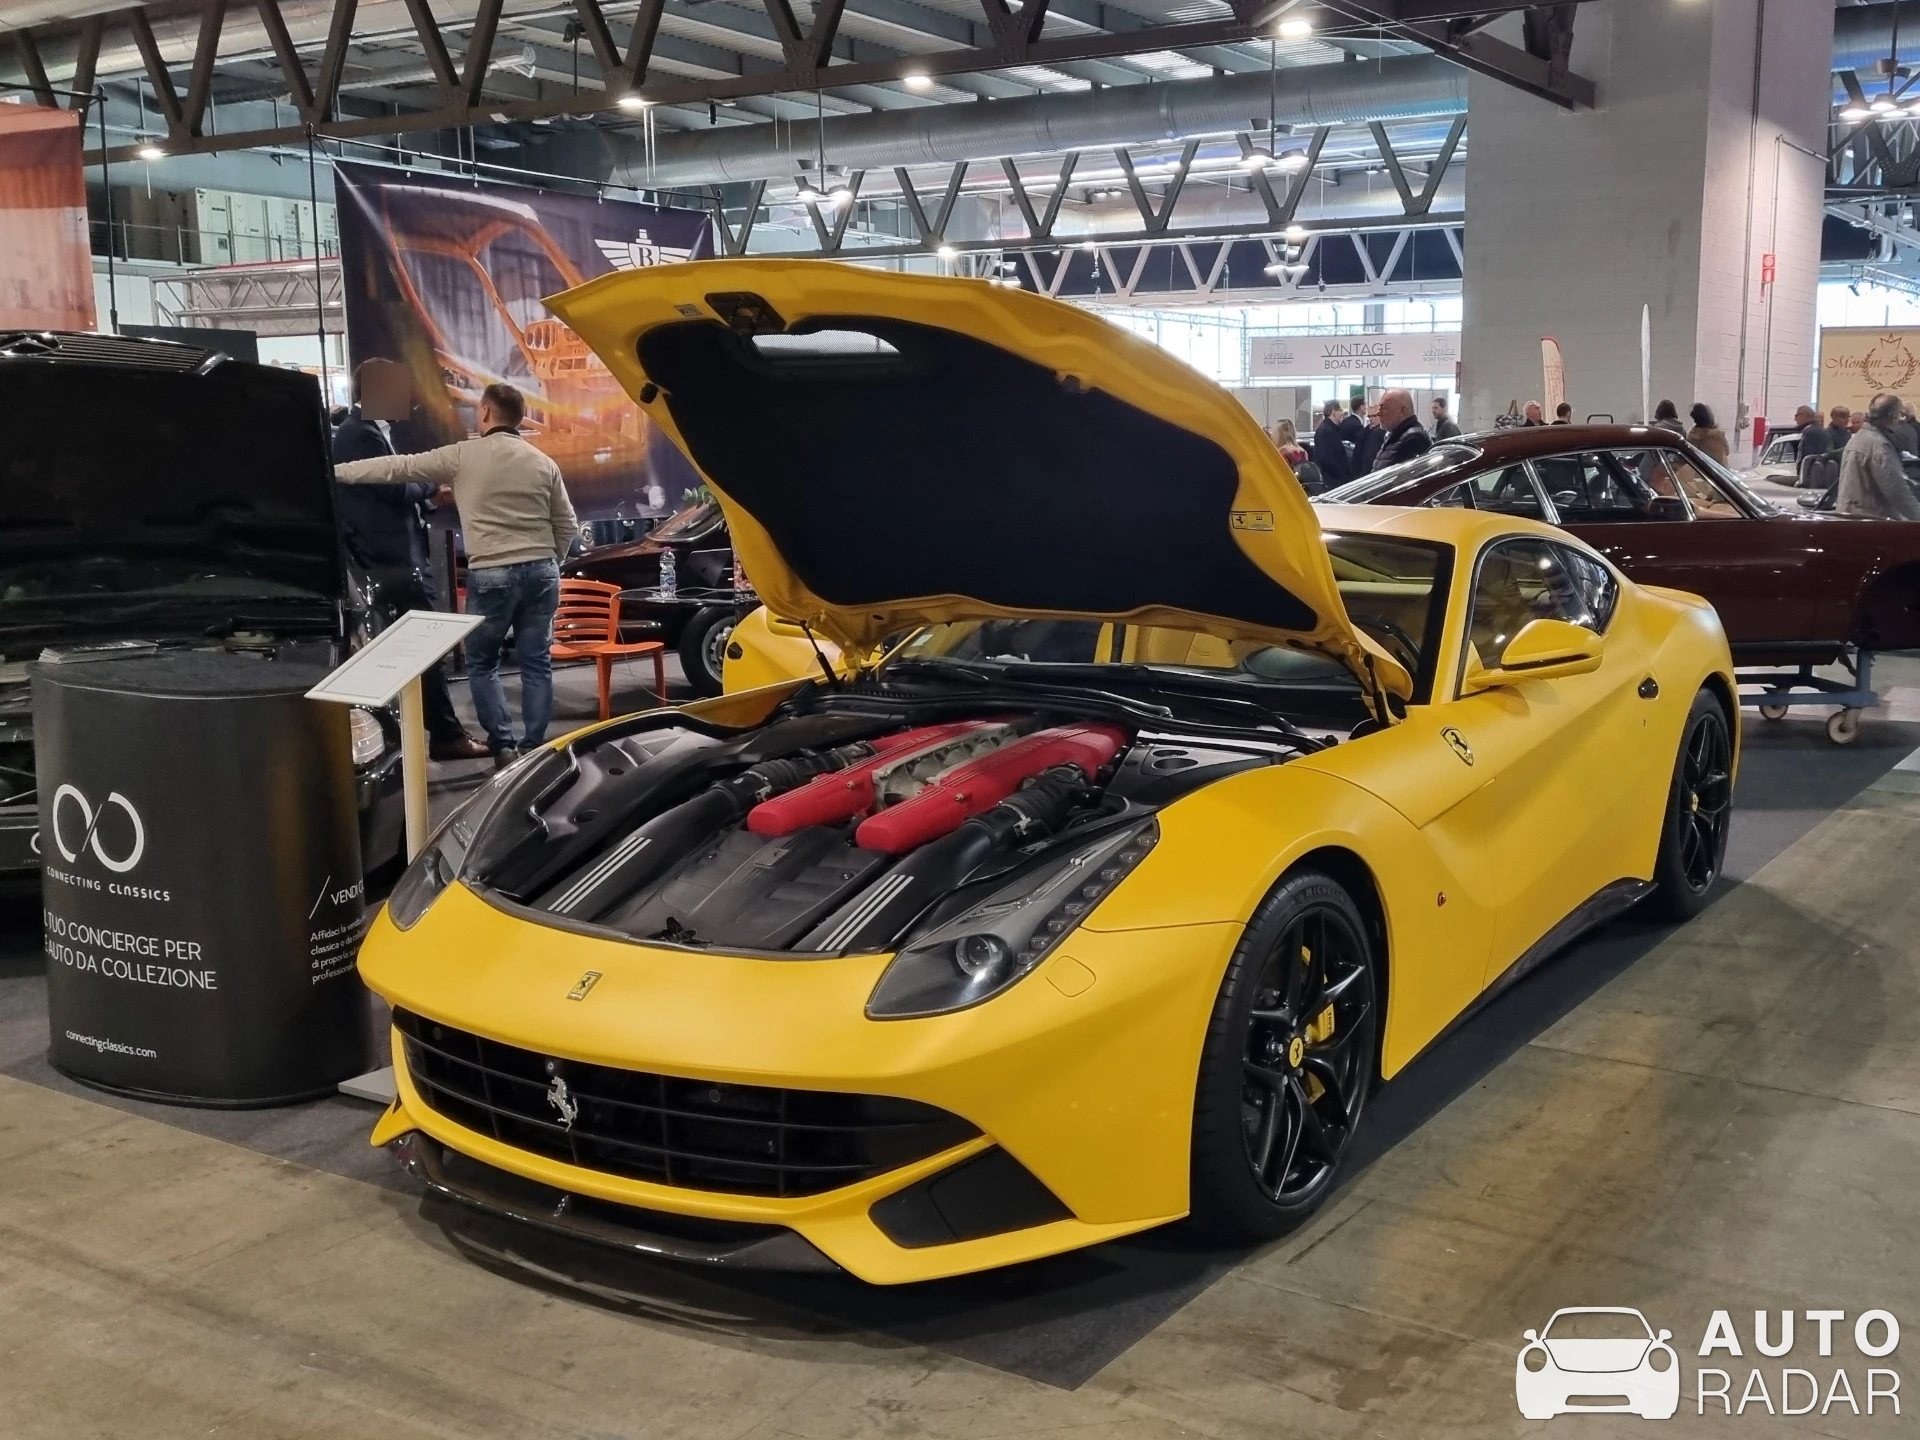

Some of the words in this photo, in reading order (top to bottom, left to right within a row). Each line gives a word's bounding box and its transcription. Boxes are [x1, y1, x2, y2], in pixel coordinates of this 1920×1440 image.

[1324, 342, 1393, 356] VINTAGE
[1324, 359, 1352, 370] BOAT
[1355, 358, 1391, 369] SHOW
[47, 866, 101, 891] CONNECTING
[330, 883, 358, 906] VENDI
[48, 911, 66, 936] TUO
[68, 921, 160, 957] CONCIERGE
[165, 939, 202, 961] PER
[310, 928, 340, 943] Affidaci
[311, 942, 340, 956] classica
[49, 939, 74, 967] AUTO
[76, 951, 98, 974] DA
[102, 957, 218, 990] COLLEZIONE
[312, 959, 319, 969] di
[65, 1029, 157, 1059] connectingclassics.com
